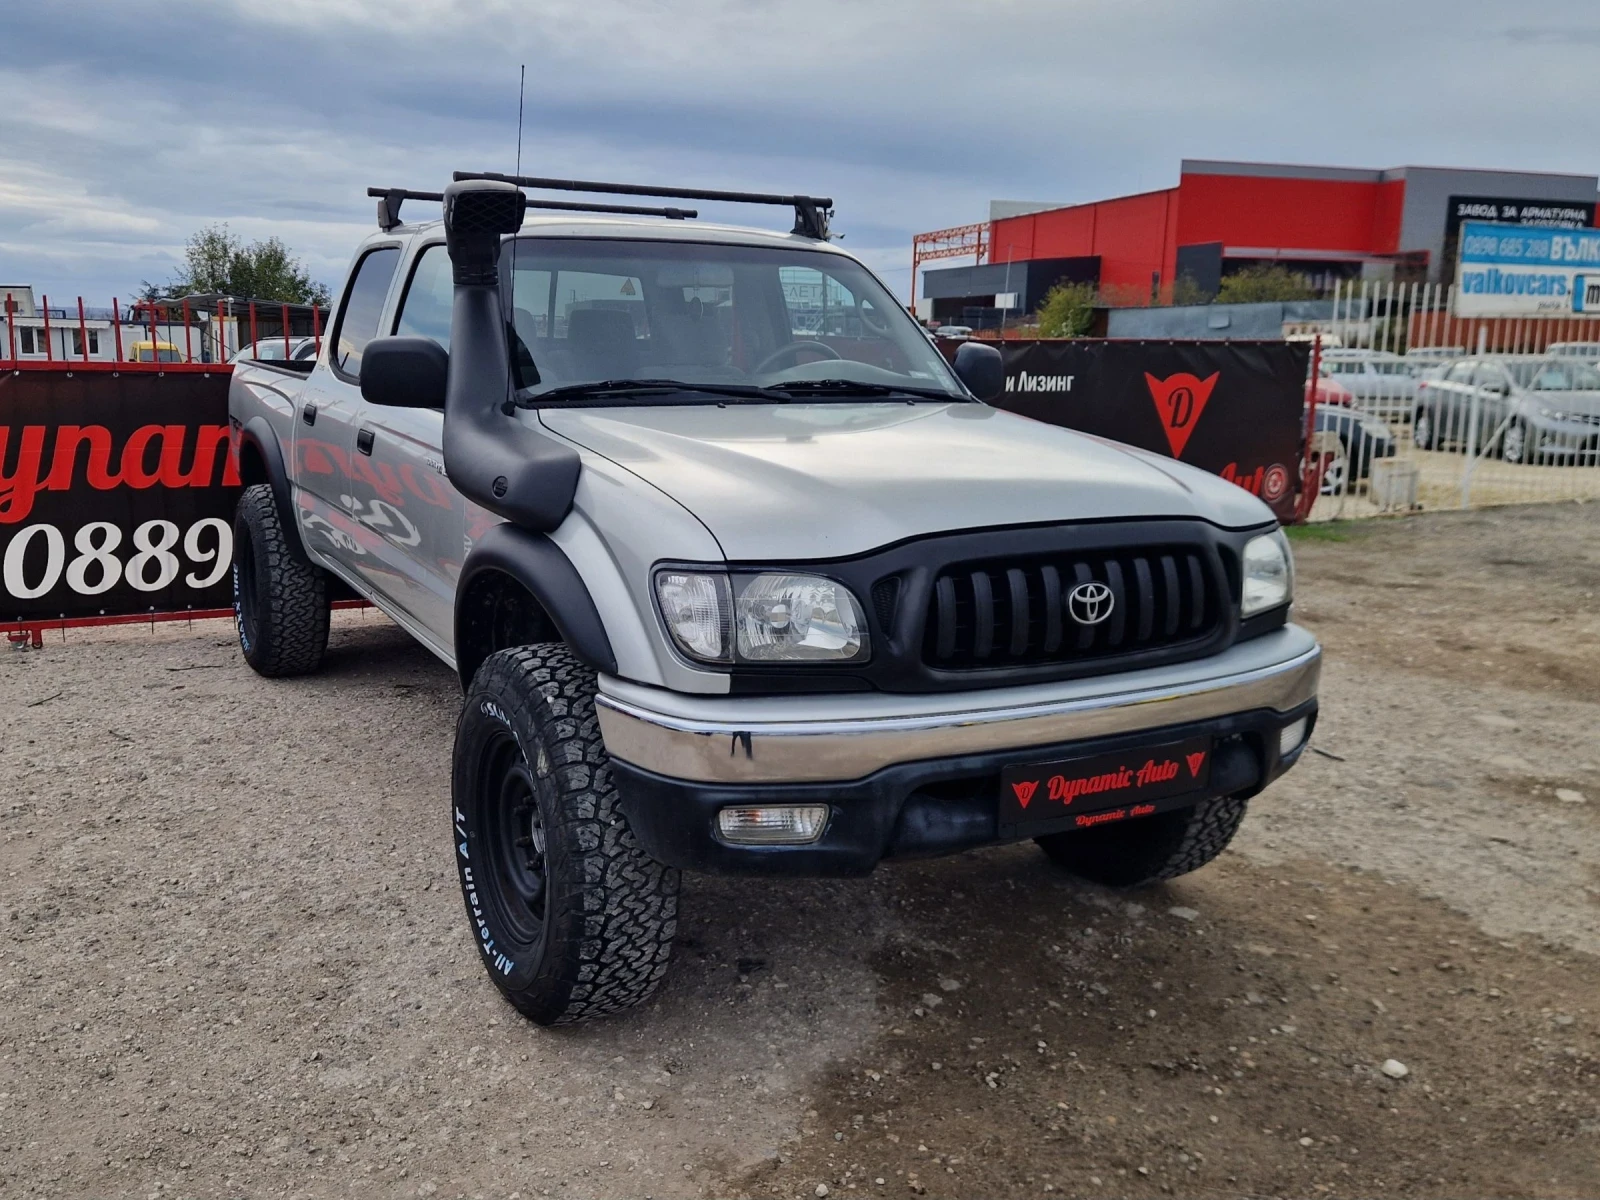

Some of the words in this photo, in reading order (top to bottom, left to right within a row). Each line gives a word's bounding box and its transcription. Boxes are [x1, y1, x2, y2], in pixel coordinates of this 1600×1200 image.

[1457, 204, 1498, 218] ЗАВОД
[1501, 206, 1518, 218] ЗА
[1520, 207, 1587, 221] АРМАТУРНА
[1005, 376, 1014, 392] и
[1017, 370, 1075, 392] Лизинг
[1168, 387, 1194, 428] D
[3, 517, 234, 599] 0889
[1047, 766, 1133, 804] Dynamic
[1136, 759, 1179, 788] Auto
[454, 806, 469, 859] A/T
[1075, 809, 1126, 826] Dynamic
[1130, 804, 1156, 815] Auto
[463, 866, 514, 976] All-Terrain
